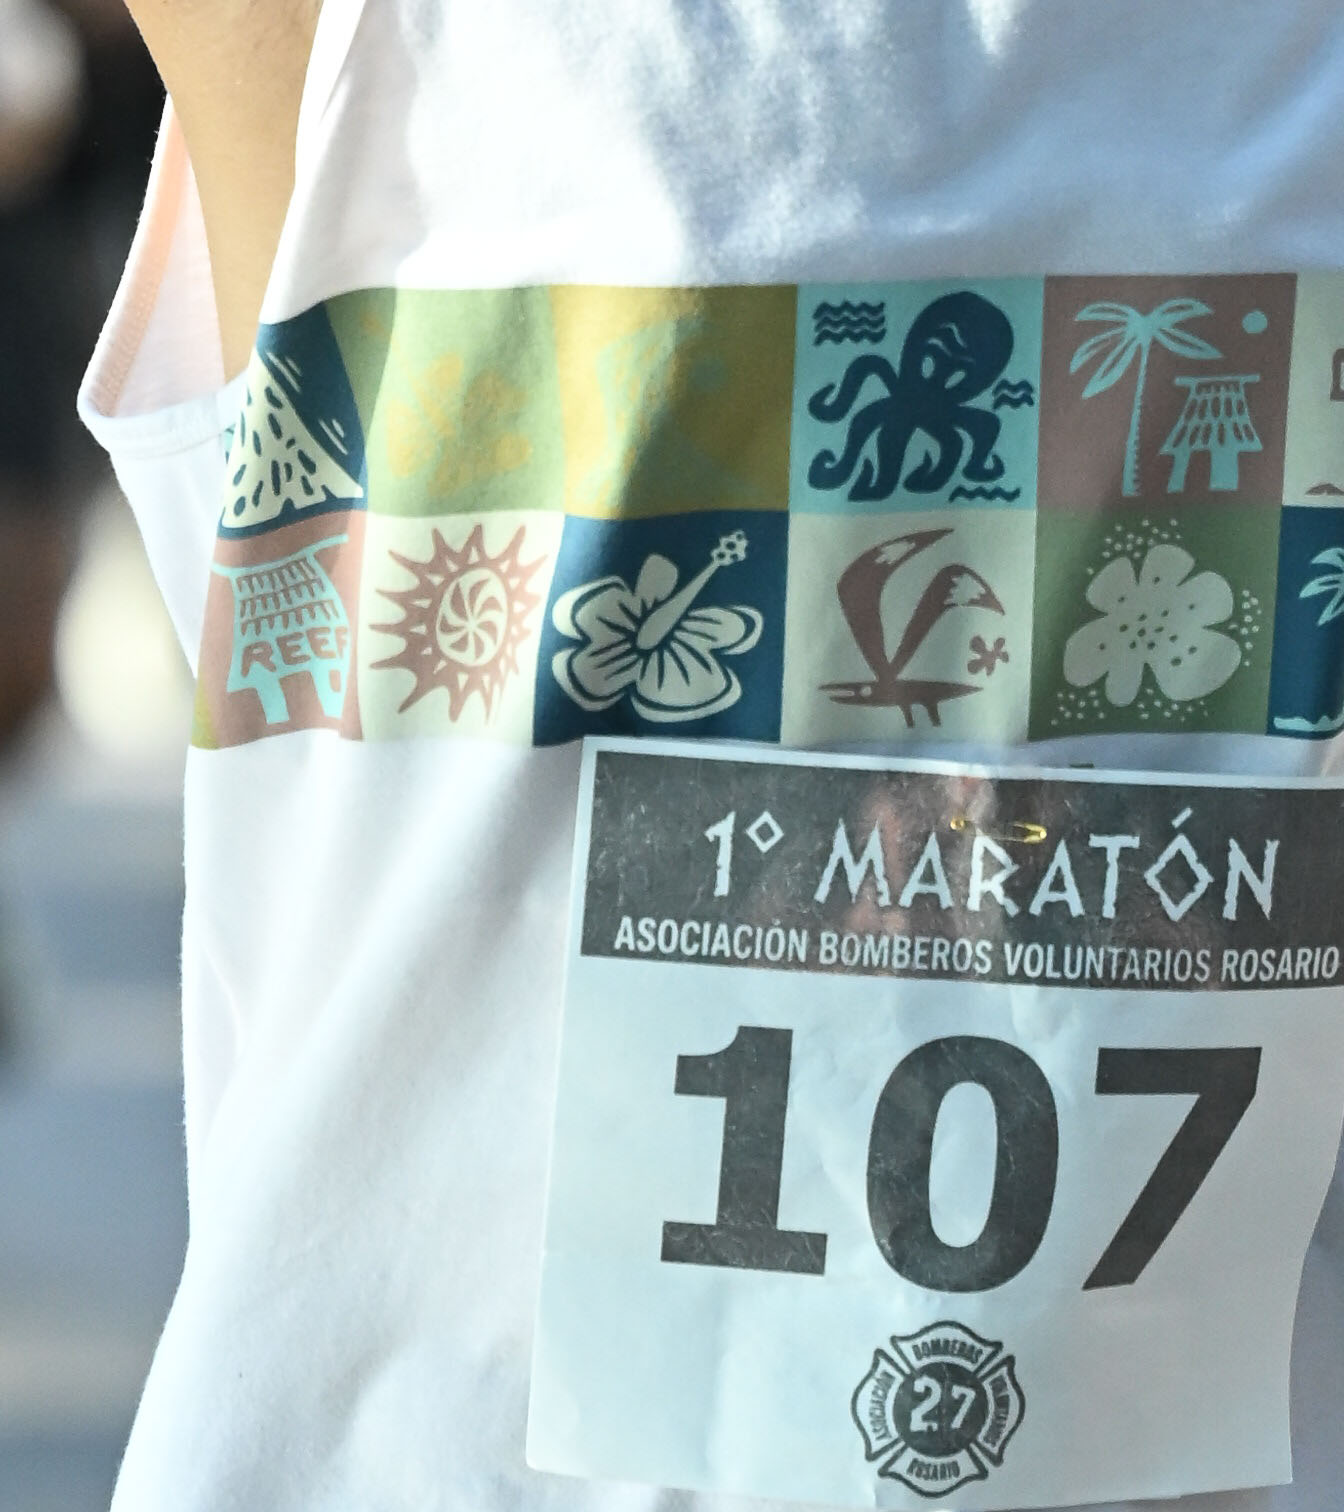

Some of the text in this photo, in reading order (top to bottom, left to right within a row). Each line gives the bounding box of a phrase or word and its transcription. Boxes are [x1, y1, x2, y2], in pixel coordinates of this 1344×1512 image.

[240, 626, 348, 678] REEF
[812, 807, 1280, 922] MARATÓN
[613, 915, 1340, 984] ASOCIACIÓN BOMBEROS VOLUNTARIOS ROSARIO
[660, 1026, 1263, 1295] 107
[909, 1376, 977, 1433] 27
